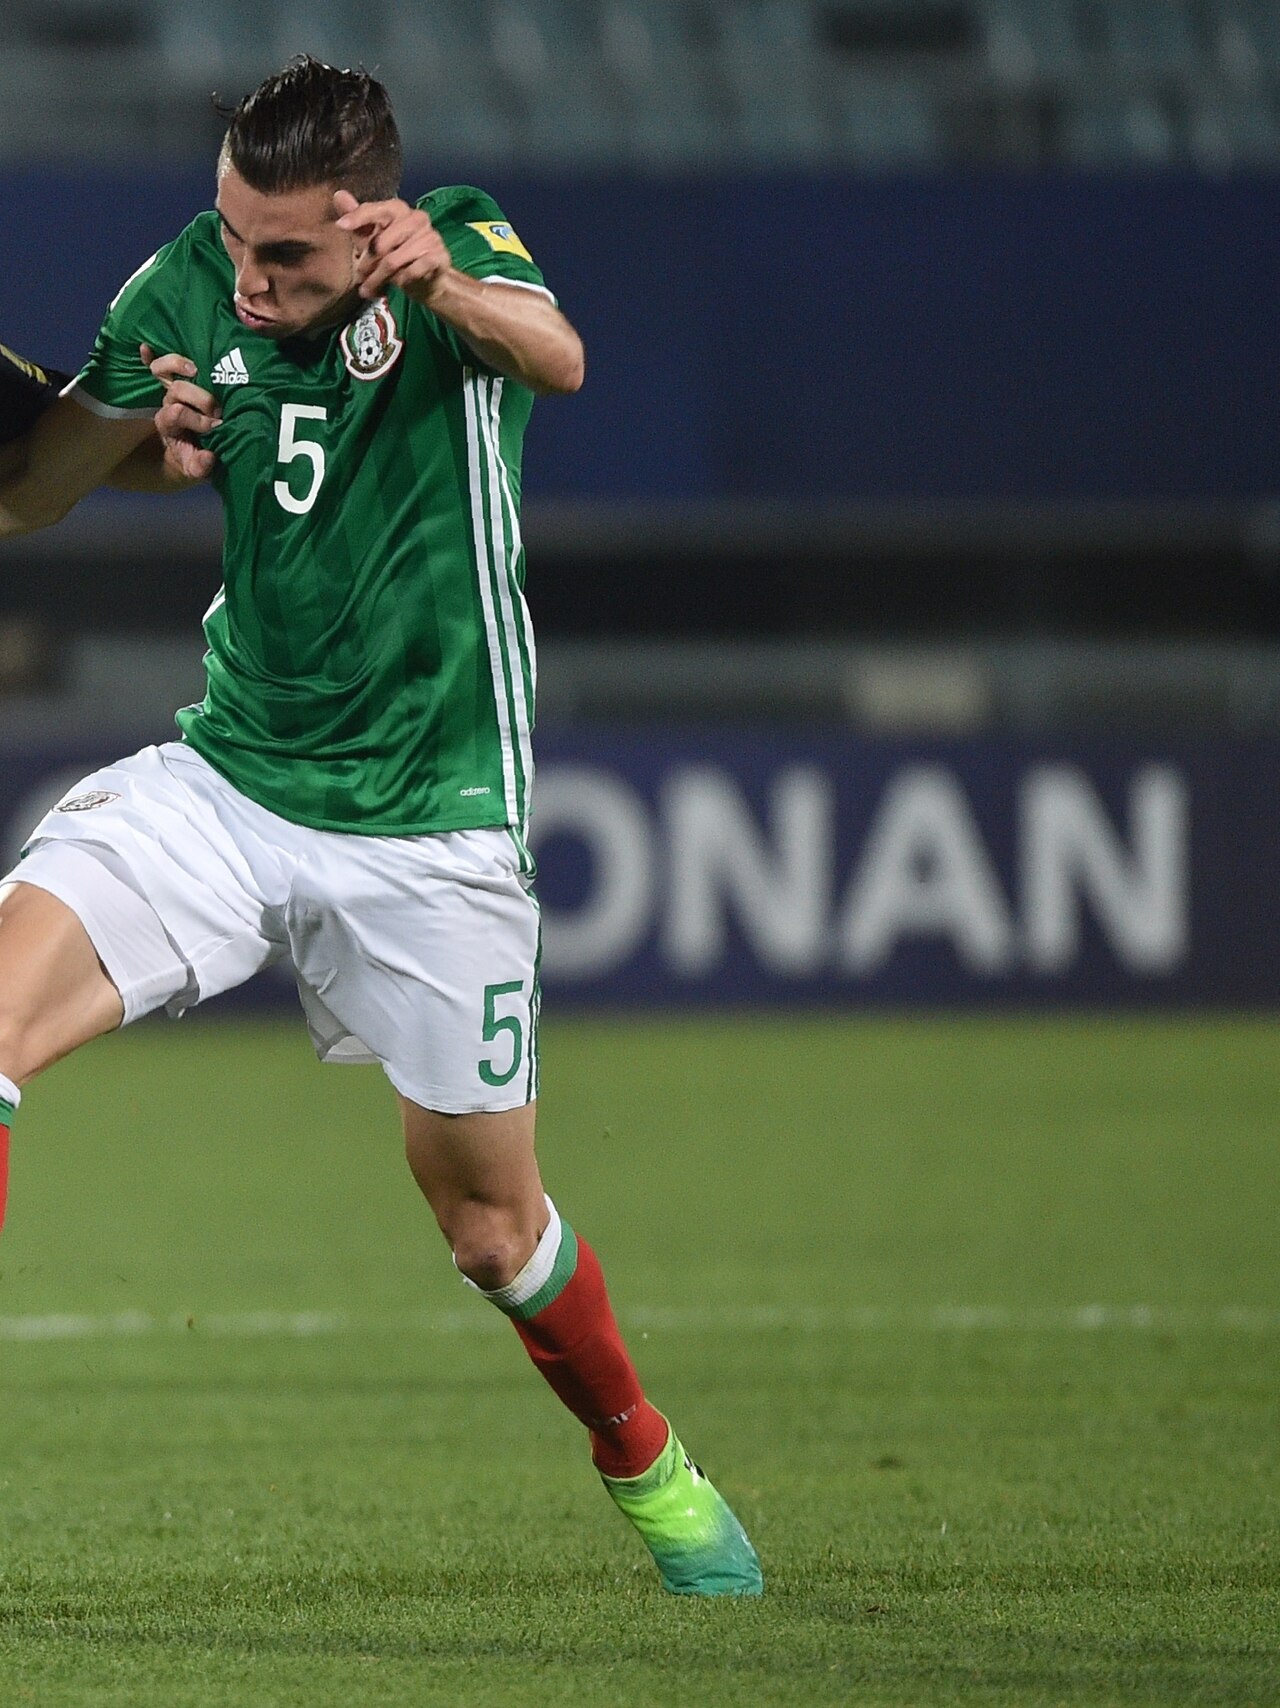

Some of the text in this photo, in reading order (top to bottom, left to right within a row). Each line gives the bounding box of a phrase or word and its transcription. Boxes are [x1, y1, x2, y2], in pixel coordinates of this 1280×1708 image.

[210, 370, 250, 385] adidas
[274, 402, 328, 515] 5
[478, 979, 525, 1088] 5
